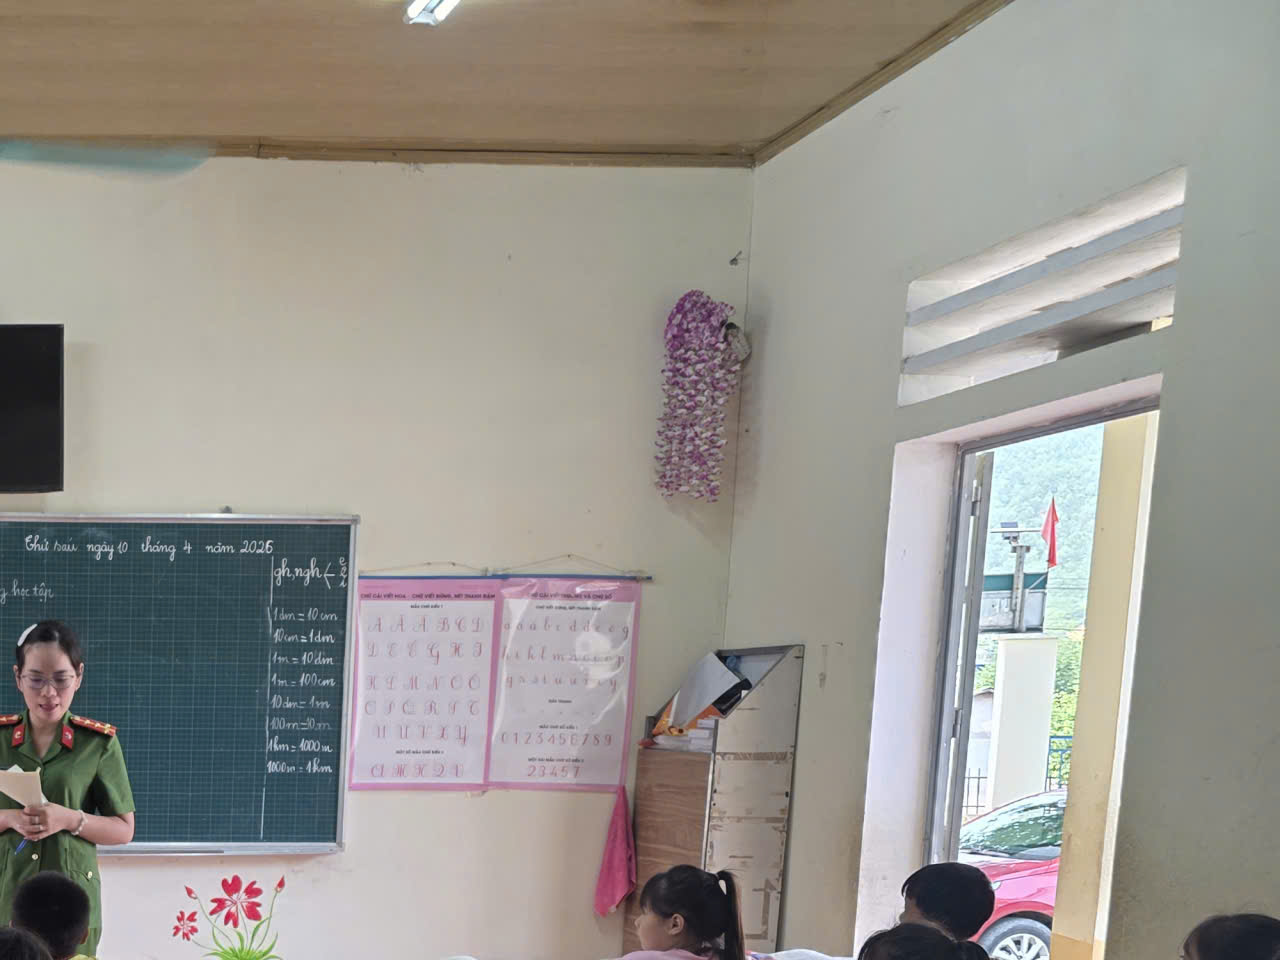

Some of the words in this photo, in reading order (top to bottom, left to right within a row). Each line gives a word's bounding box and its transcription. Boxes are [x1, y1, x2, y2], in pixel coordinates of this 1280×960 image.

[141, 535, 177, 562] tháng
[183, 540, 193, 554] 4
[239, 540, 274, 555] 2026
